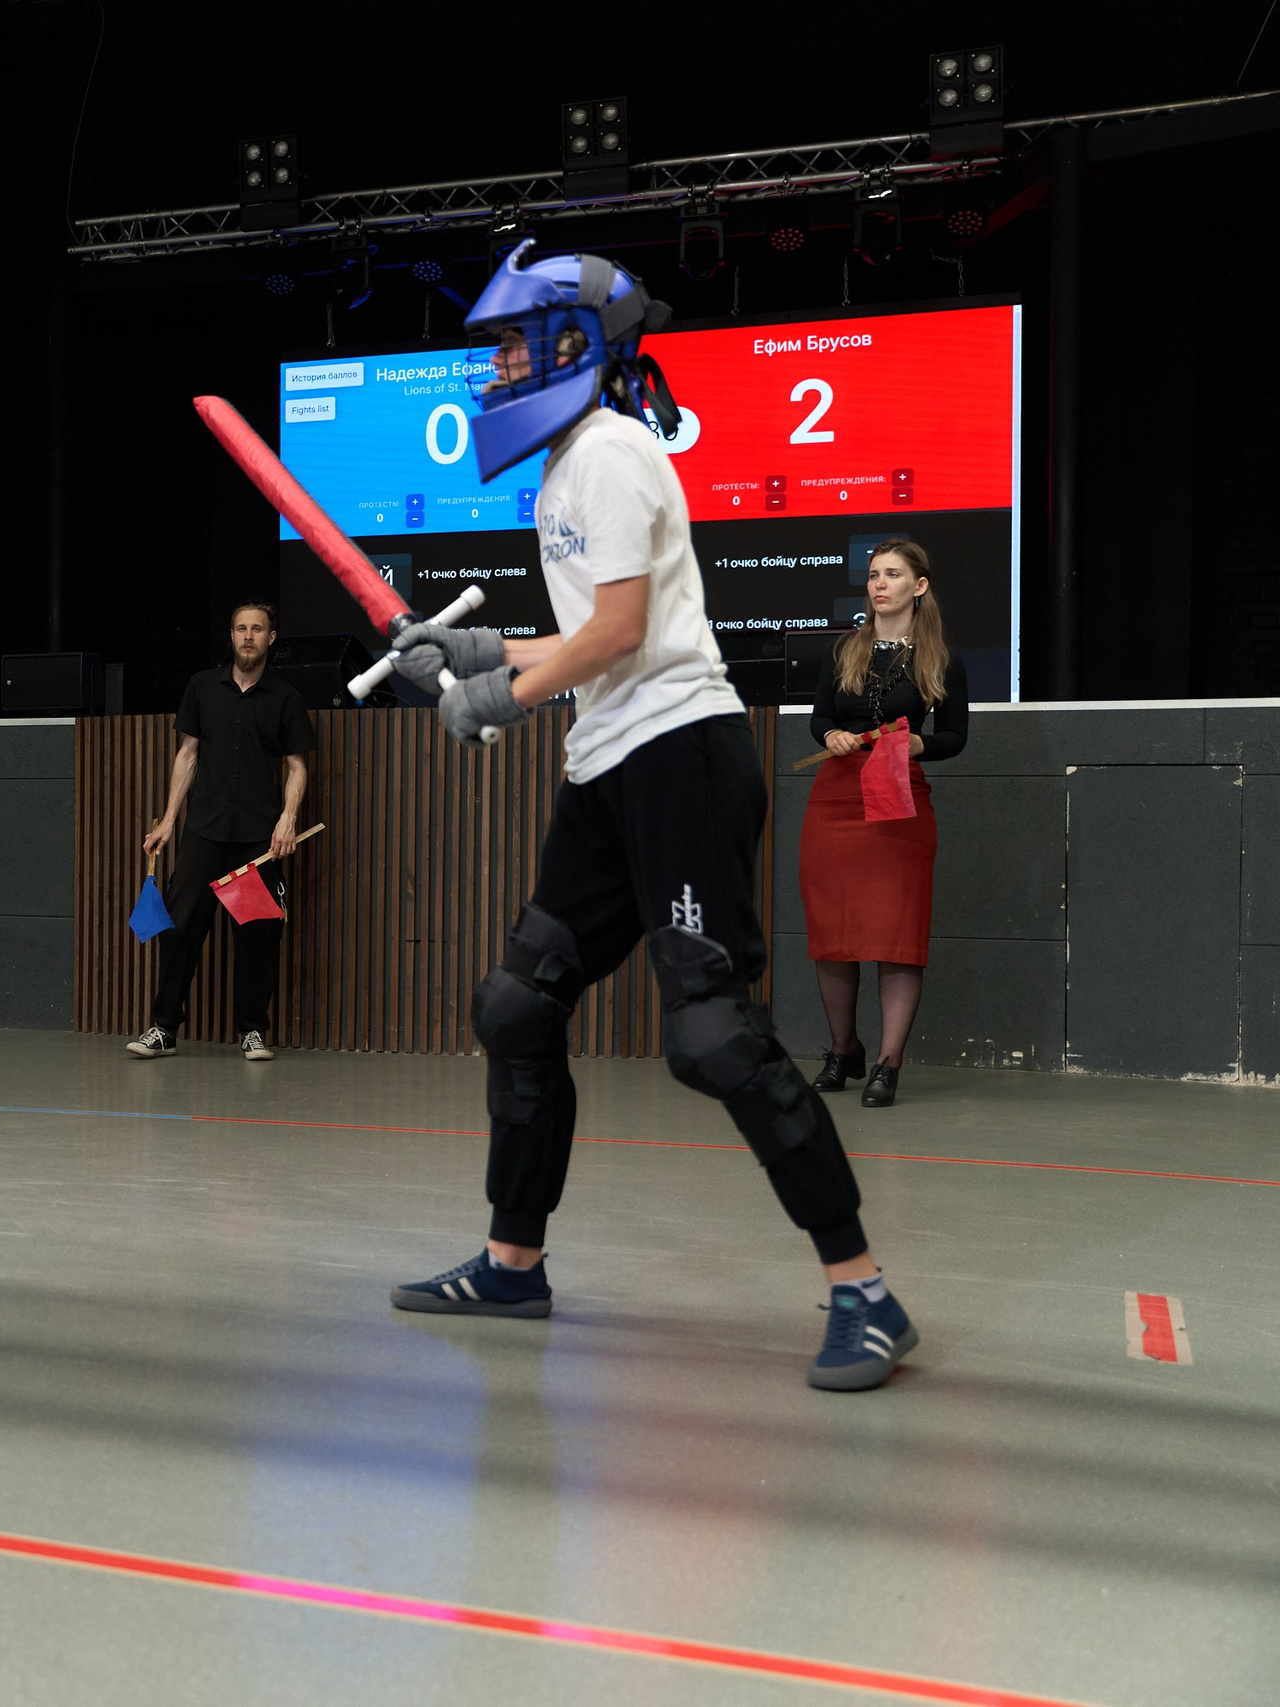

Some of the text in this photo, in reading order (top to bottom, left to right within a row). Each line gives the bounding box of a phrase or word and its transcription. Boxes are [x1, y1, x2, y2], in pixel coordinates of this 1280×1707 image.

[753, 334, 872, 356] Ефим Брусов
[291, 370, 358, 384] История баллов
[376, 366, 447, 382] Надежда
[404, 384, 432, 396] Lions
[435, 383, 445, 394] of
[448, 382, 461, 393] St.
[291, 404, 329, 417] Fights list
[790, 378, 834, 444] 2
[426, 403, 469, 465] 0
[712, 475, 886, 491] ПРОТЕСТЫ: ПРЕДУПРЕЖДЕНИЯ:
[358, 495, 513, 509] ПРОТЕСТЫ: ПРЕДУПРЕЖДЕНИЯ:
[732, 496, 740, 506] 0
[839, 491, 848, 501] 0
[376, 513, 384, 523] 0
[471, 508, 479, 518] 0
[715, 554, 843, 569] +1 очко бойцу справа
[418, 565, 527, 580] +1 очко бойцу слева
[503, 626, 536, 636] слева
[716, 620, 744, 630] очко
[746, 617, 783, 631] бойцу
[785, 617, 828, 630] справа
